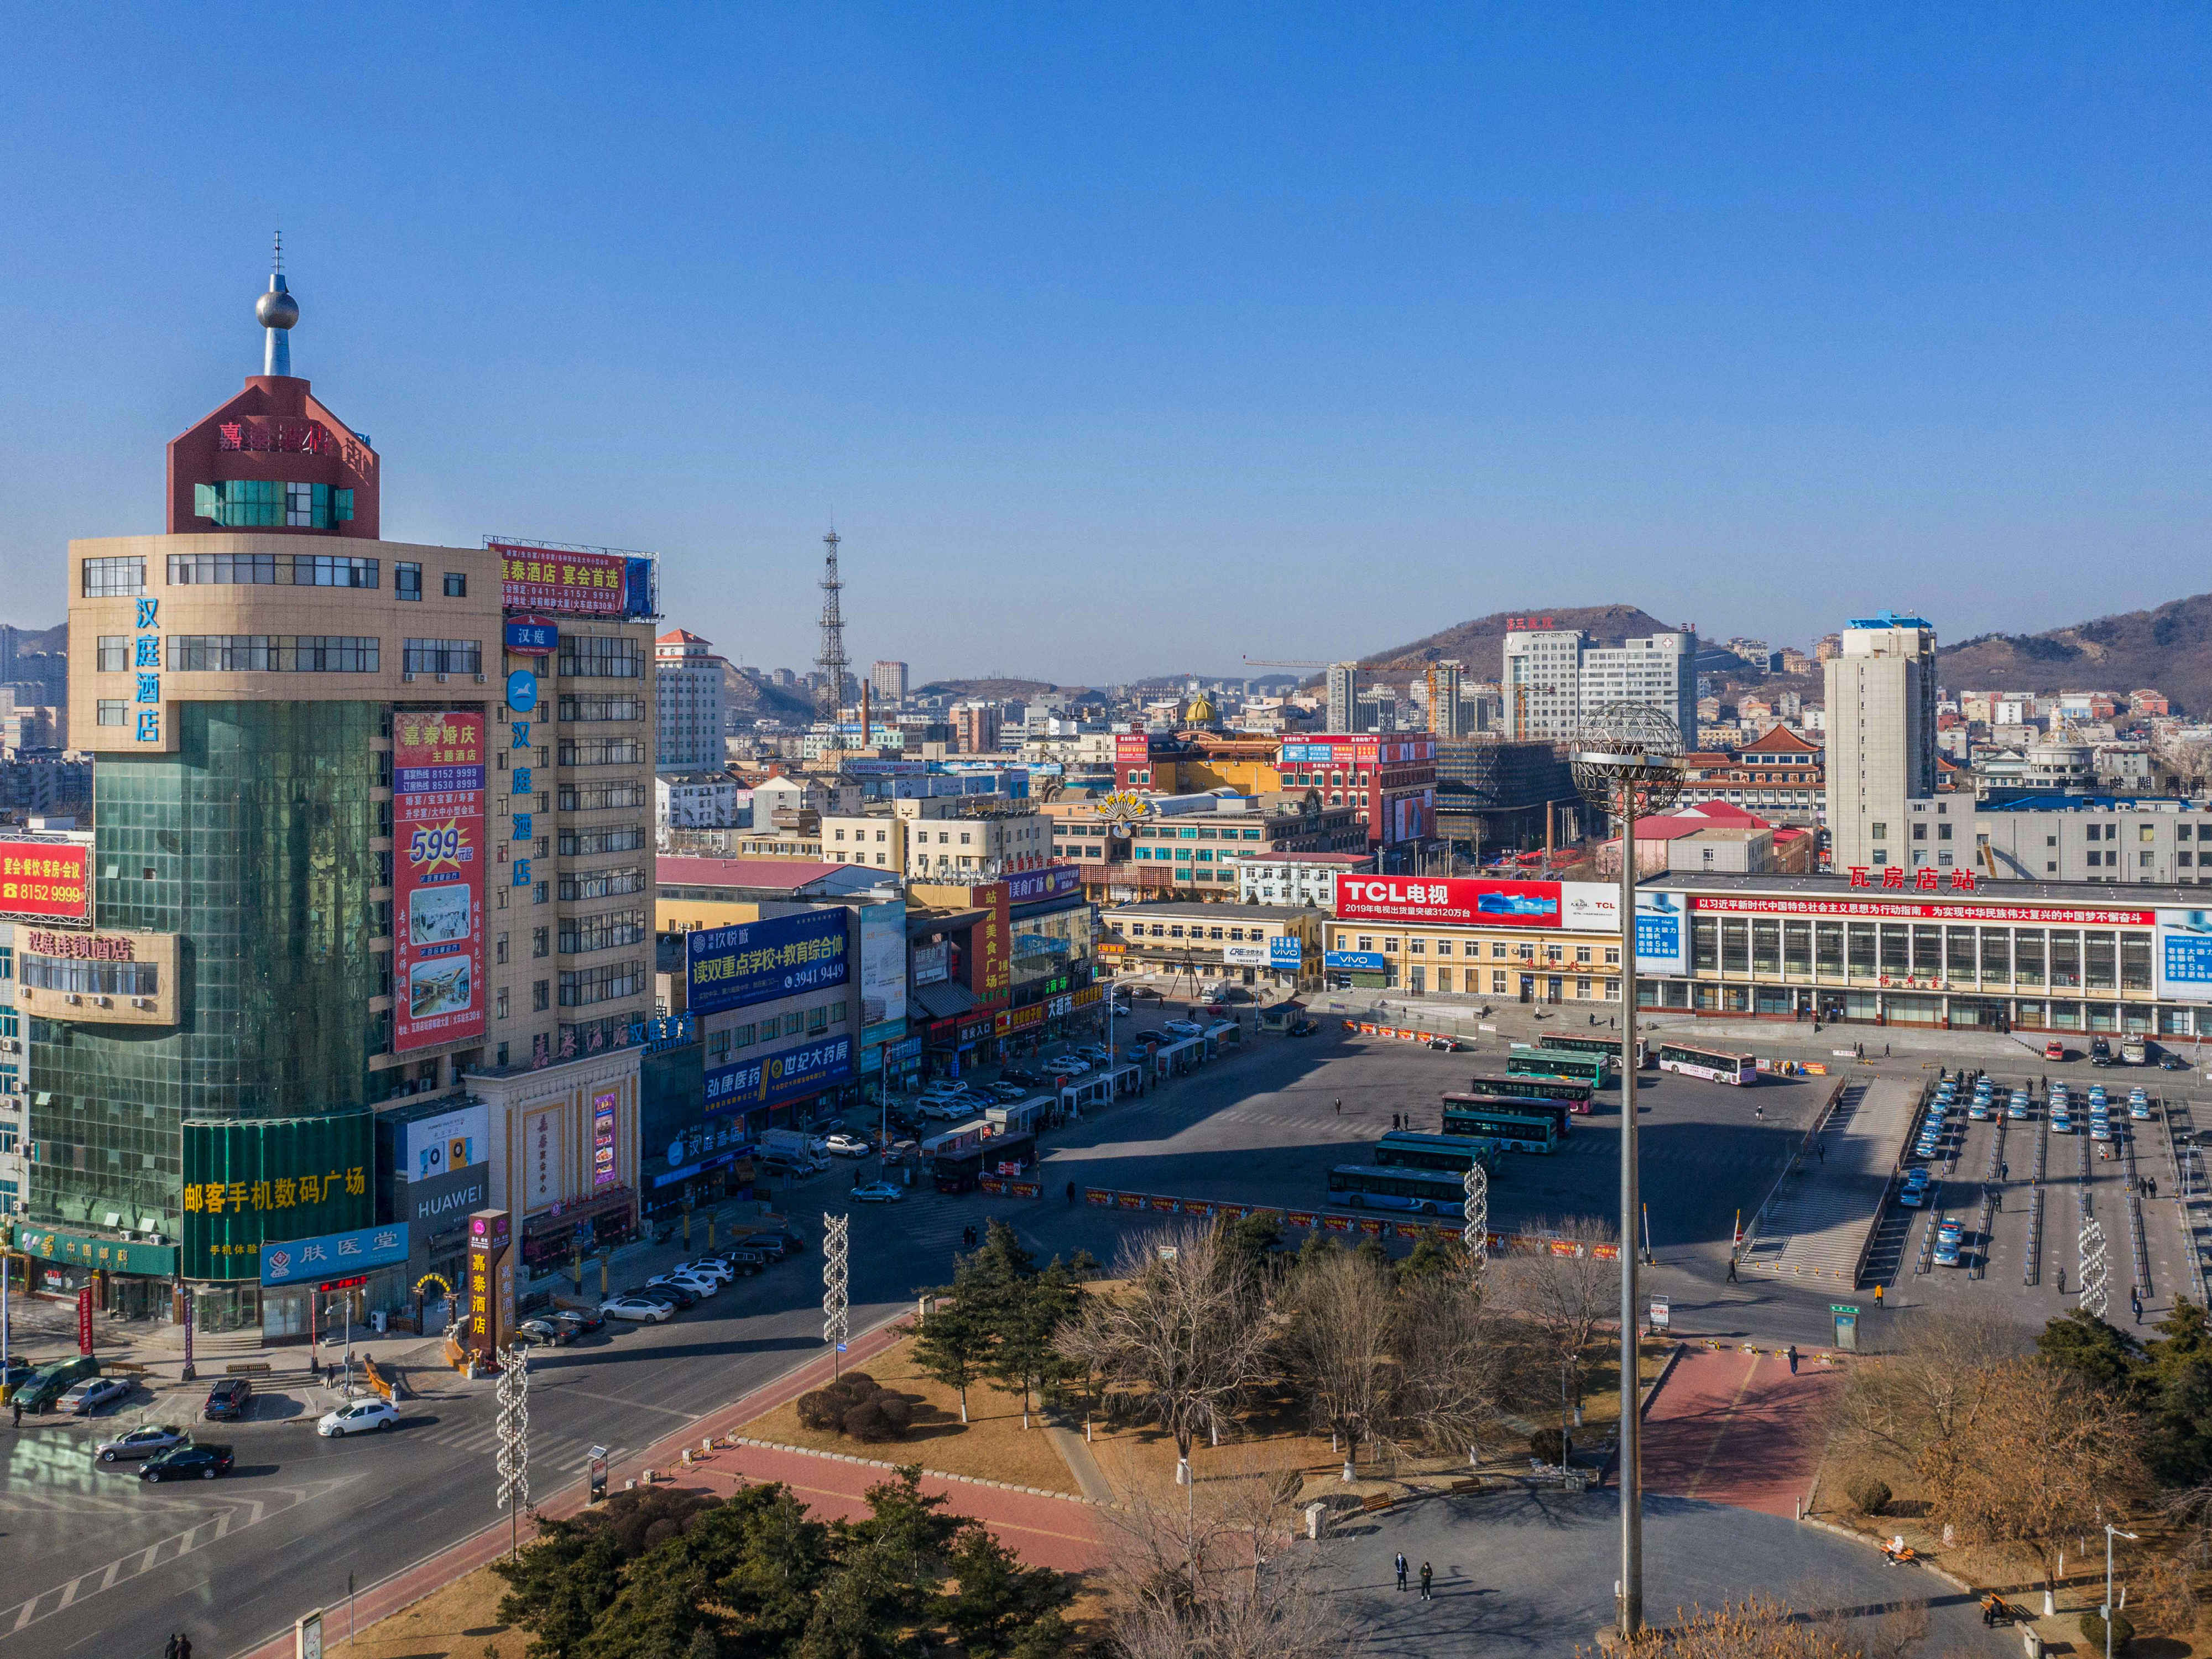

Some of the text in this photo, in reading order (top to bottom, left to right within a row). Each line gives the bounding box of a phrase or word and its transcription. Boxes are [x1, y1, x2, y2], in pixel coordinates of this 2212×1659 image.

[563, 565, 618, 588] 宴会首选
[502, 585, 615, 600] 会预定:0411-8152 9999
[502, 595, 615, 611] 店地址:站前邮政大厦(火车站东30米)
[518, 628, 545, 644] 汉庭
[135, 597, 159, 742] 汉庭酒店
[403, 725, 476, 746] 嘉泰婚庆
[432, 749, 476, 763] 主题酒店
[432, 770, 453, 779] 8152
[456, 768, 477, 777] 9999
[432, 781, 453, 790] 8530
[456, 779, 477, 788] 8999
[512, 721, 533, 886] 汉庭酒店
[409, 827, 459, 864] 599
[1009, 877, 1044, 898] 美食广场
[1848, 866, 1975, 890] 瓦房店站
[20, 884, 80, 903] 8152 9999
[1344, 881, 1448, 905] TCL电视
[1345, 904, 1470, 918] 2019年电视出货量突破3120万台
[29, 931, 131, 961] 汉庭连锁酒店
[1274, 948, 1297, 956] vivo
[693, 935, 843, 985] 读双重点学校+教育综合体
[1339, 954, 1368, 964] vivo
[1526, 957, 1580, 971] 售票处
[794, 972, 817, 988] 3941
[821, 963, 844, 982] 9449
[1879, 975, 1943, 989] 候车室
[1048, 995, 1072, 1019] 大超市
[962, 1023, 989, 1041] 美食入口
[784, 1040, 848, 1076] 世纪大药房
[707, 1065, 761, 1098] 弘康医药
[184, 1166, 366, 1213] 邮客手机数码广场
[418, 1185, 482, 1219] HUAWEI
[66, 1241, 129, 1262] 中国邮政
[210, 1244, 258, 1256] 手机体验
[300, 1231, 399, 1264] 肤医堂
[99, 1261, 129, 1270] POST
[472, 1254, 486, 1335] 嘉泰酒店
[501, 1265, 513, 1327] 嘉泰酒店
